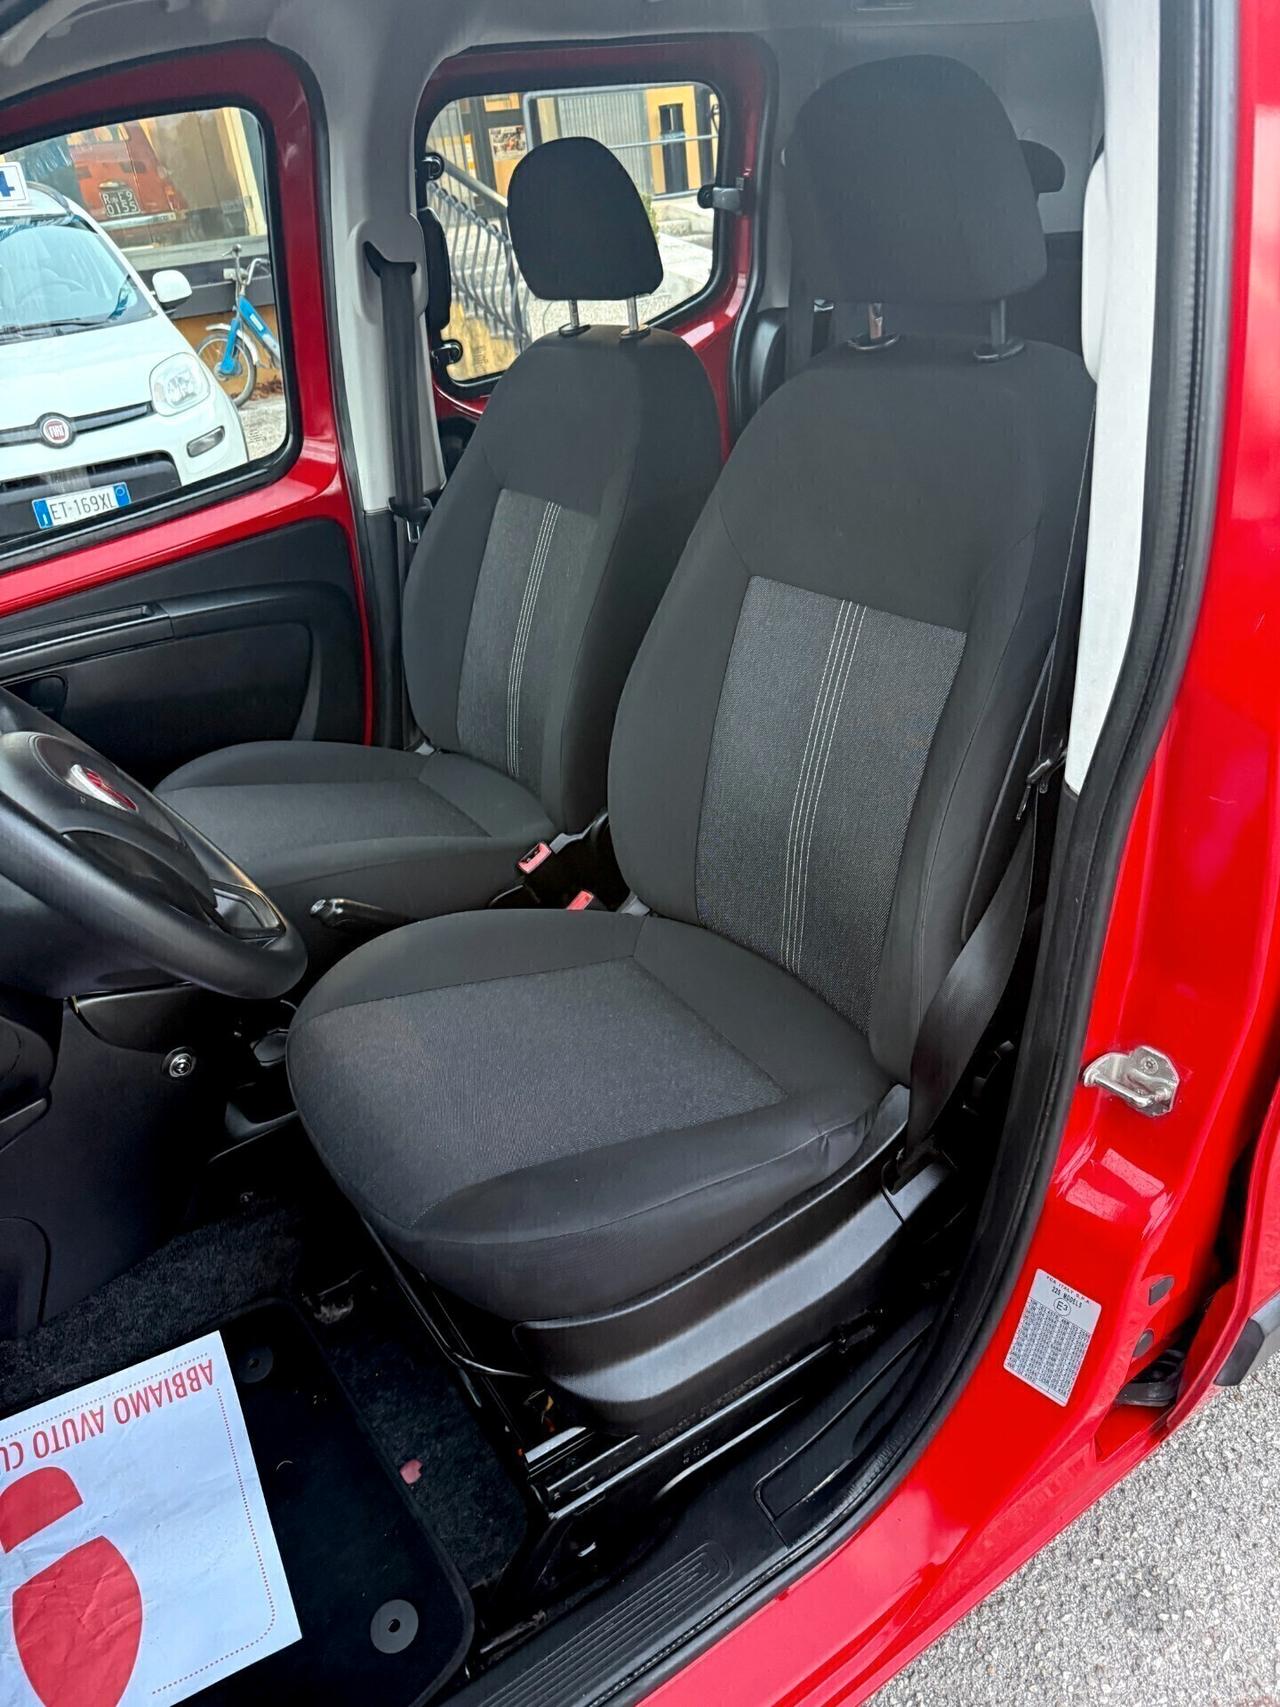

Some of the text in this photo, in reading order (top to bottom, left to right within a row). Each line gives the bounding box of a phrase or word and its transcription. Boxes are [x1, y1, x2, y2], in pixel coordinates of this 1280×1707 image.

[106, 200, 137, 215] 0155
[1051, 1286, 1082, 1308] 225 MODELS
[113, 1359, 213, 1425] ABBIAMO
[32, 1405, 105, 1459] AVUTO
